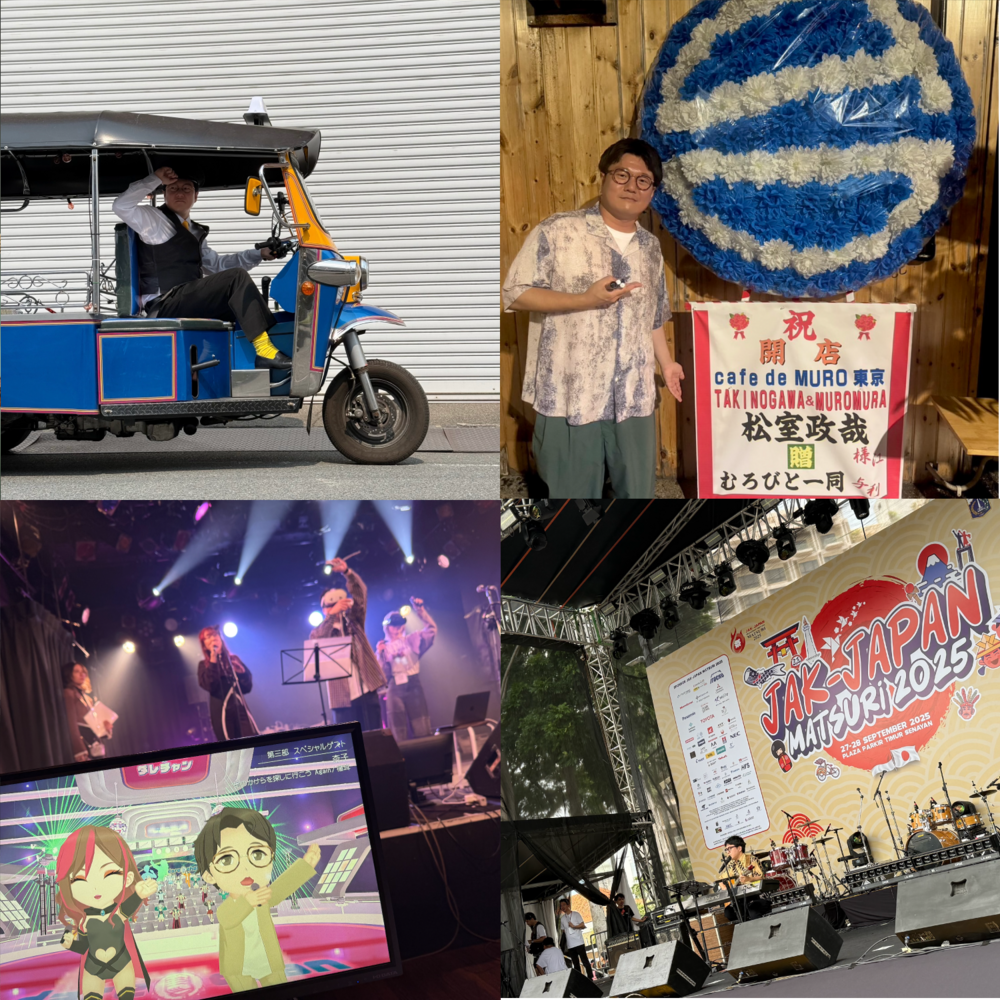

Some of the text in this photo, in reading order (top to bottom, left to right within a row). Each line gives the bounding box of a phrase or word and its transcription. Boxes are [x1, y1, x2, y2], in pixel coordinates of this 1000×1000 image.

[783, 310, 817, 341] 祝
[714, 368, 885, 387] cafe de MURO 東京
[741, 411, 870, 445] 松室政哉
[789, 446, 813, 469] 贈
[720, 471, 845, 492] むろびと一同
[762, 566, 983, 735] JAK-JAPAN
[894, 637, 968, 704] 2025
[840, 712, 931, 753] 27-28 SEPTEMBER 2025
[842, 720, 933, 759] PLAZA PARKIR TIMUR SENAYAN
[266, 740, 346, 759] 第三部 スペシャルゲスト
